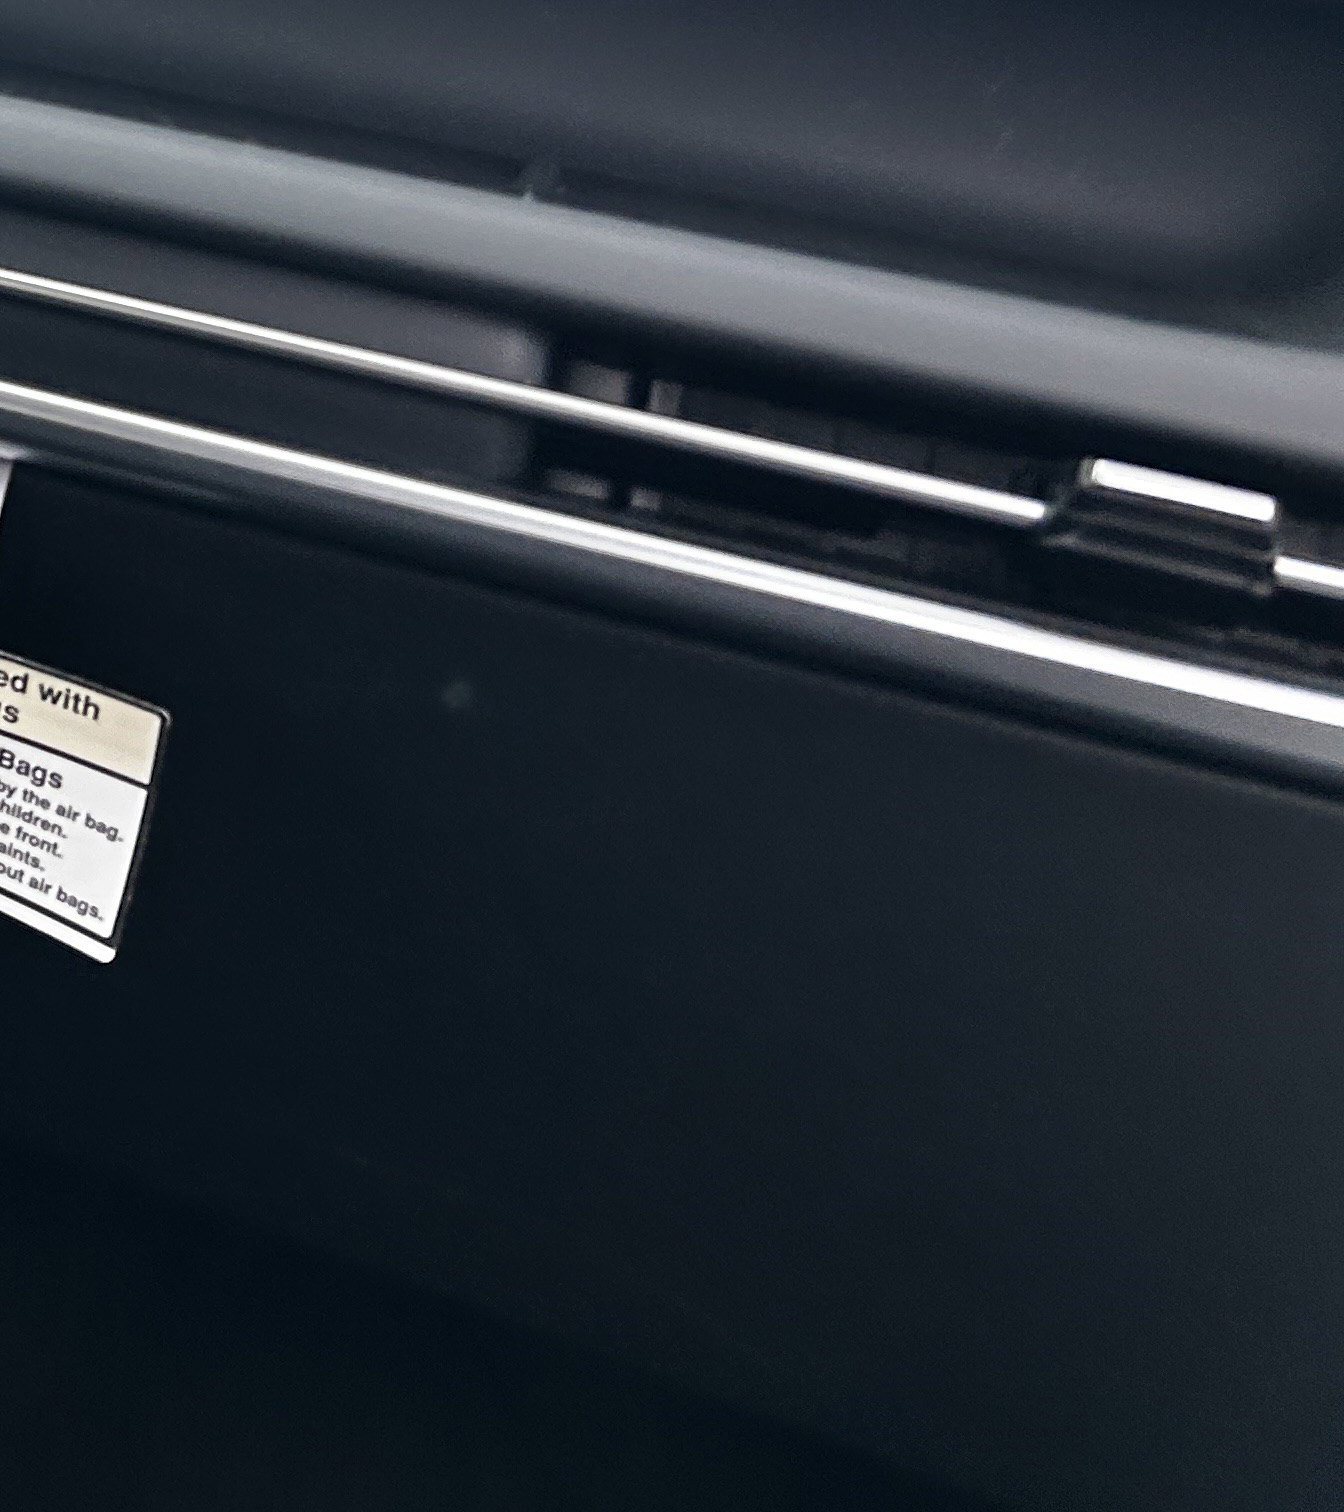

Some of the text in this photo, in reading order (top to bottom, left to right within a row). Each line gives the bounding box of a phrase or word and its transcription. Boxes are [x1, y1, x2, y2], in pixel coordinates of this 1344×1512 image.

[39, 682, 101, 721] with
[22, 788, 51, 810] the
[55, 804, 81, 822] air
[84, 813, 124, 842] bag.
[15, 826, 63, 858] front.
[28, 875, 53, 895] air
[55, 885, 105, 921] bags.
